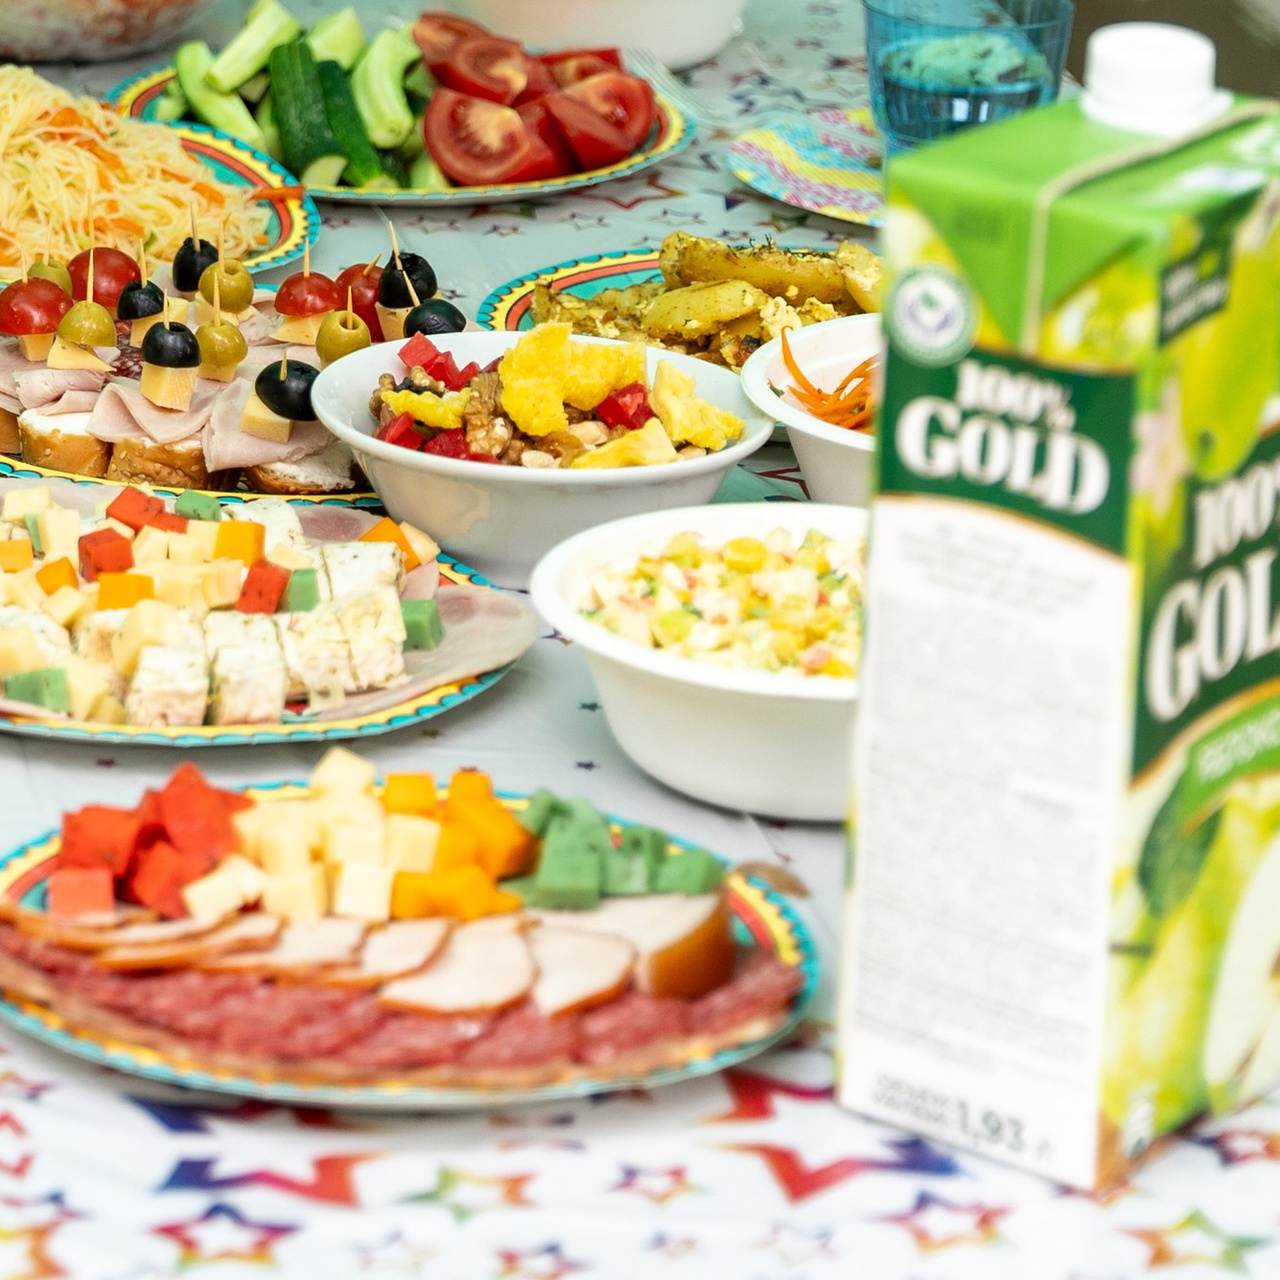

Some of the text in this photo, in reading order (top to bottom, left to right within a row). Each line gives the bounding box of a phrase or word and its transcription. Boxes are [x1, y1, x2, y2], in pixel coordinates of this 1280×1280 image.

[895, 396, 1110, 516] GOLD
[957, 360, 1077, 432] 100%
[1144, 548, 1280, 721] GOL
